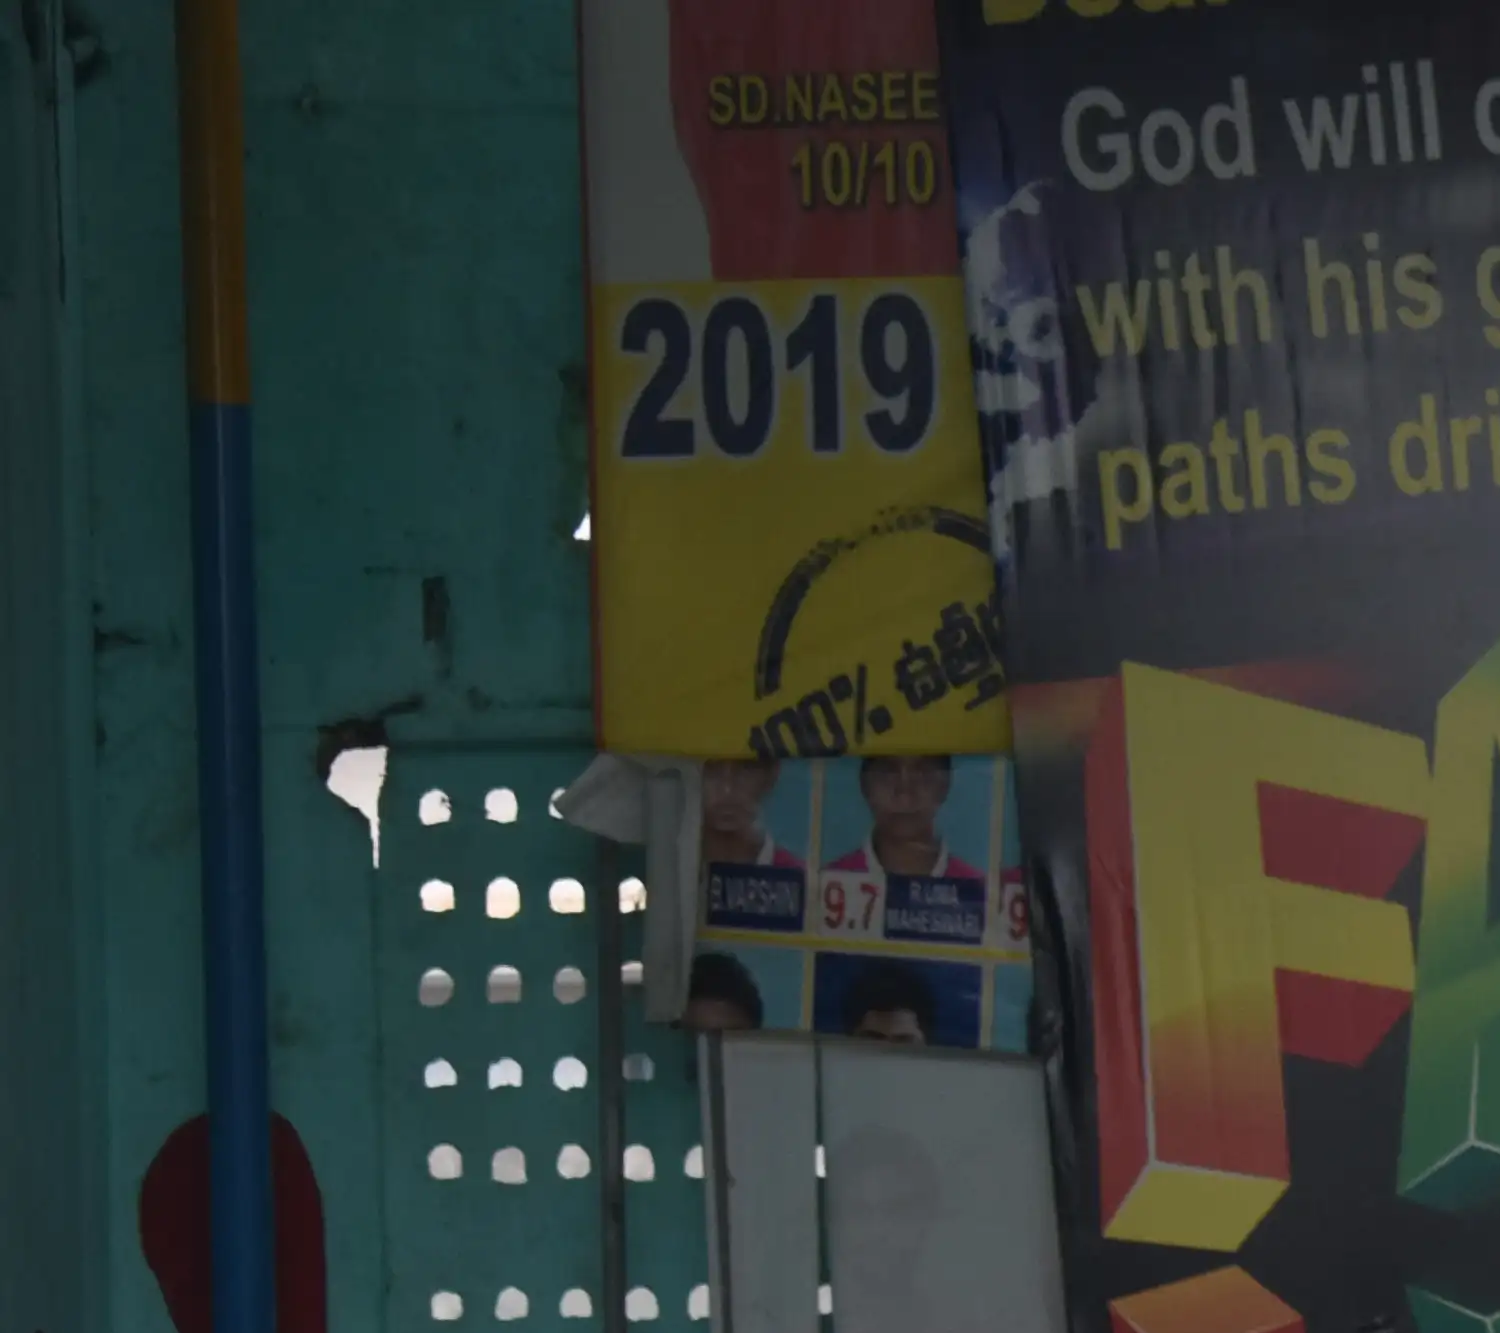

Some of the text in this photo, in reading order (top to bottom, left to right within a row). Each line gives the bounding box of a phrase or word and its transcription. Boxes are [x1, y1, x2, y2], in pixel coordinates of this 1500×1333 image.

[709, 71, 940, 125] SD.NASEE
[1060, 75, 1257, 191] God
[1282, 59, 1442, 171] will
[791, 141, 935, 206] 10/10
[1076, 245, 1271, 358] with
[1304, 232, 1443, 338] his
[620, 291, 936, 458] 2019
[1099, 409, 1356, 550] paths
[822, 881, 878, 931] 9.7
